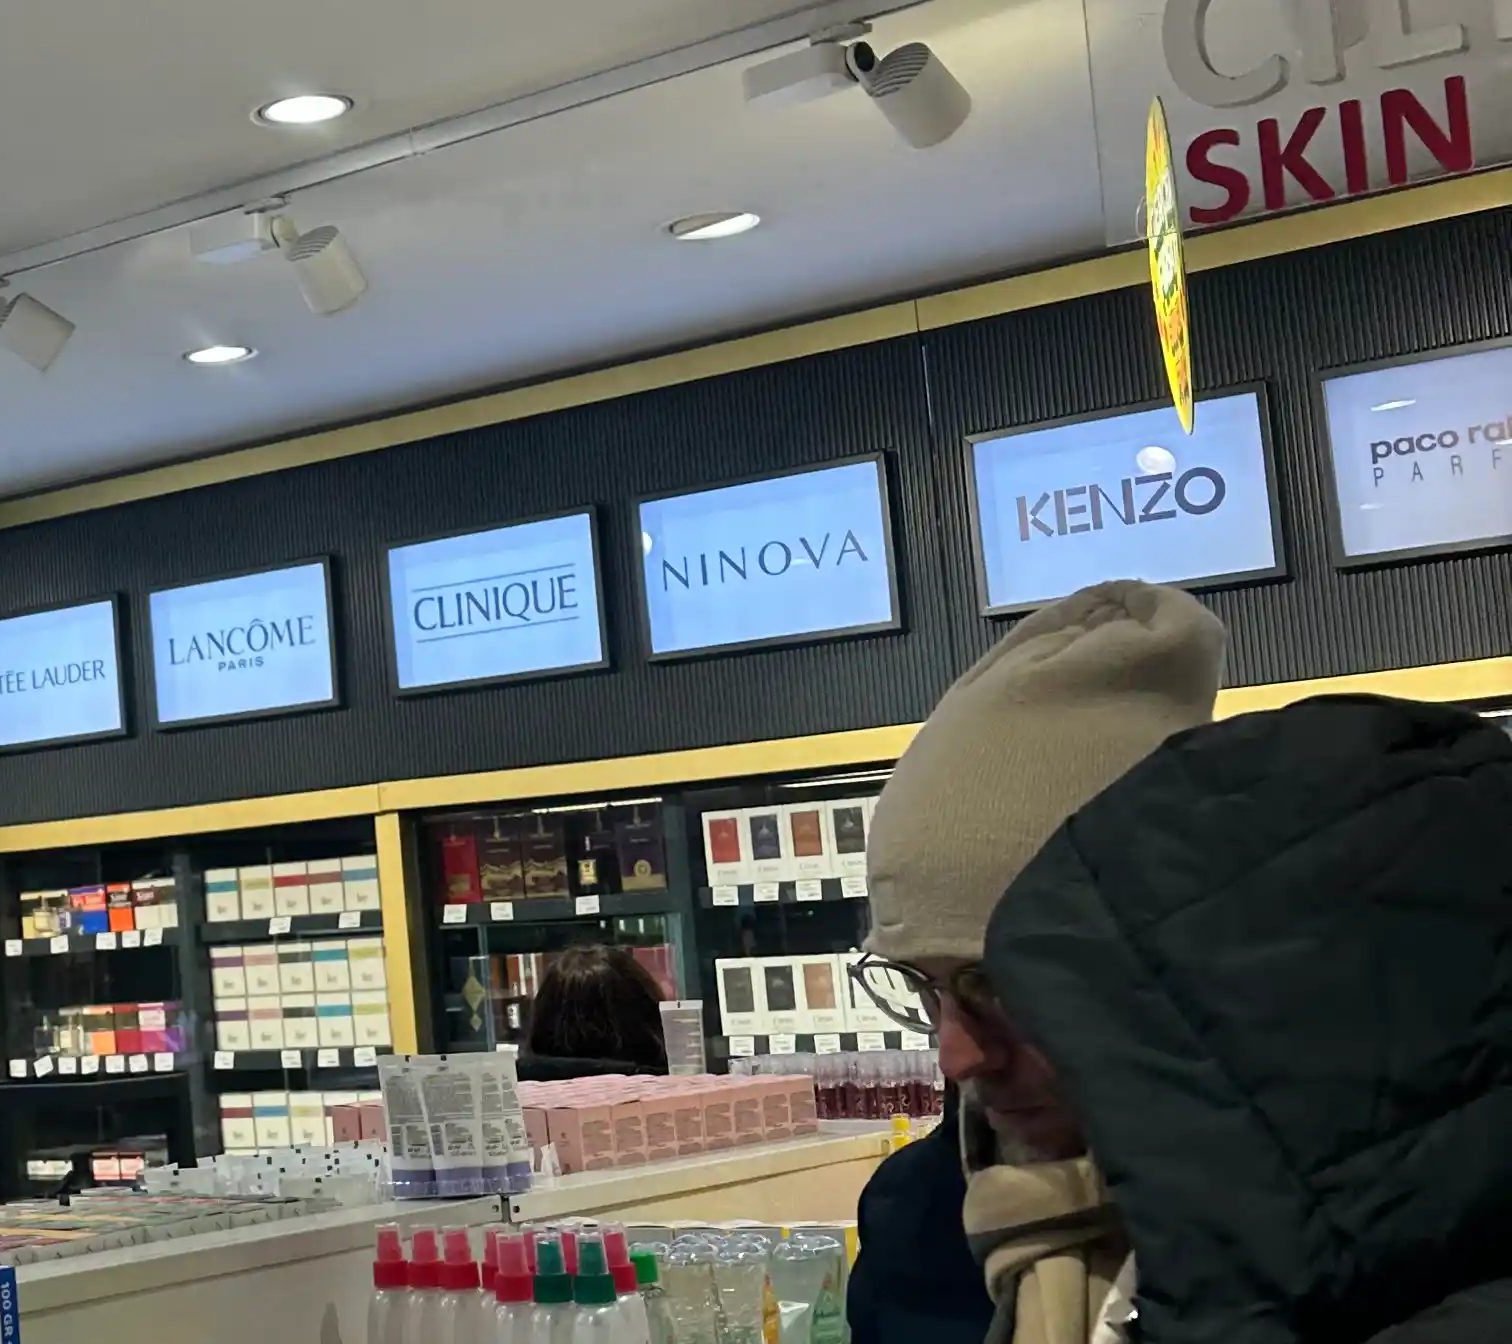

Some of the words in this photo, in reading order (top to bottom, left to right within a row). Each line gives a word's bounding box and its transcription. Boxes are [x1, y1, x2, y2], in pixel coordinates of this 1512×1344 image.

[1185, 75, 1474, 224] SKIN
[1370, 430, 1459, 465] paco
[1016, 467, 1226, 541] KENZO
[661, 528, 870, 592] NINOVA
[413, 572, 579, 633] CLINIQUE
[168, 615, 316, 667] LANCÔME
[33, 659, 106, 693] LAUDER
[217, 655, 266, 673] PARIS
[0, 1281, 12, 1310] 100
[2, 1312, 14, 1337] GR
